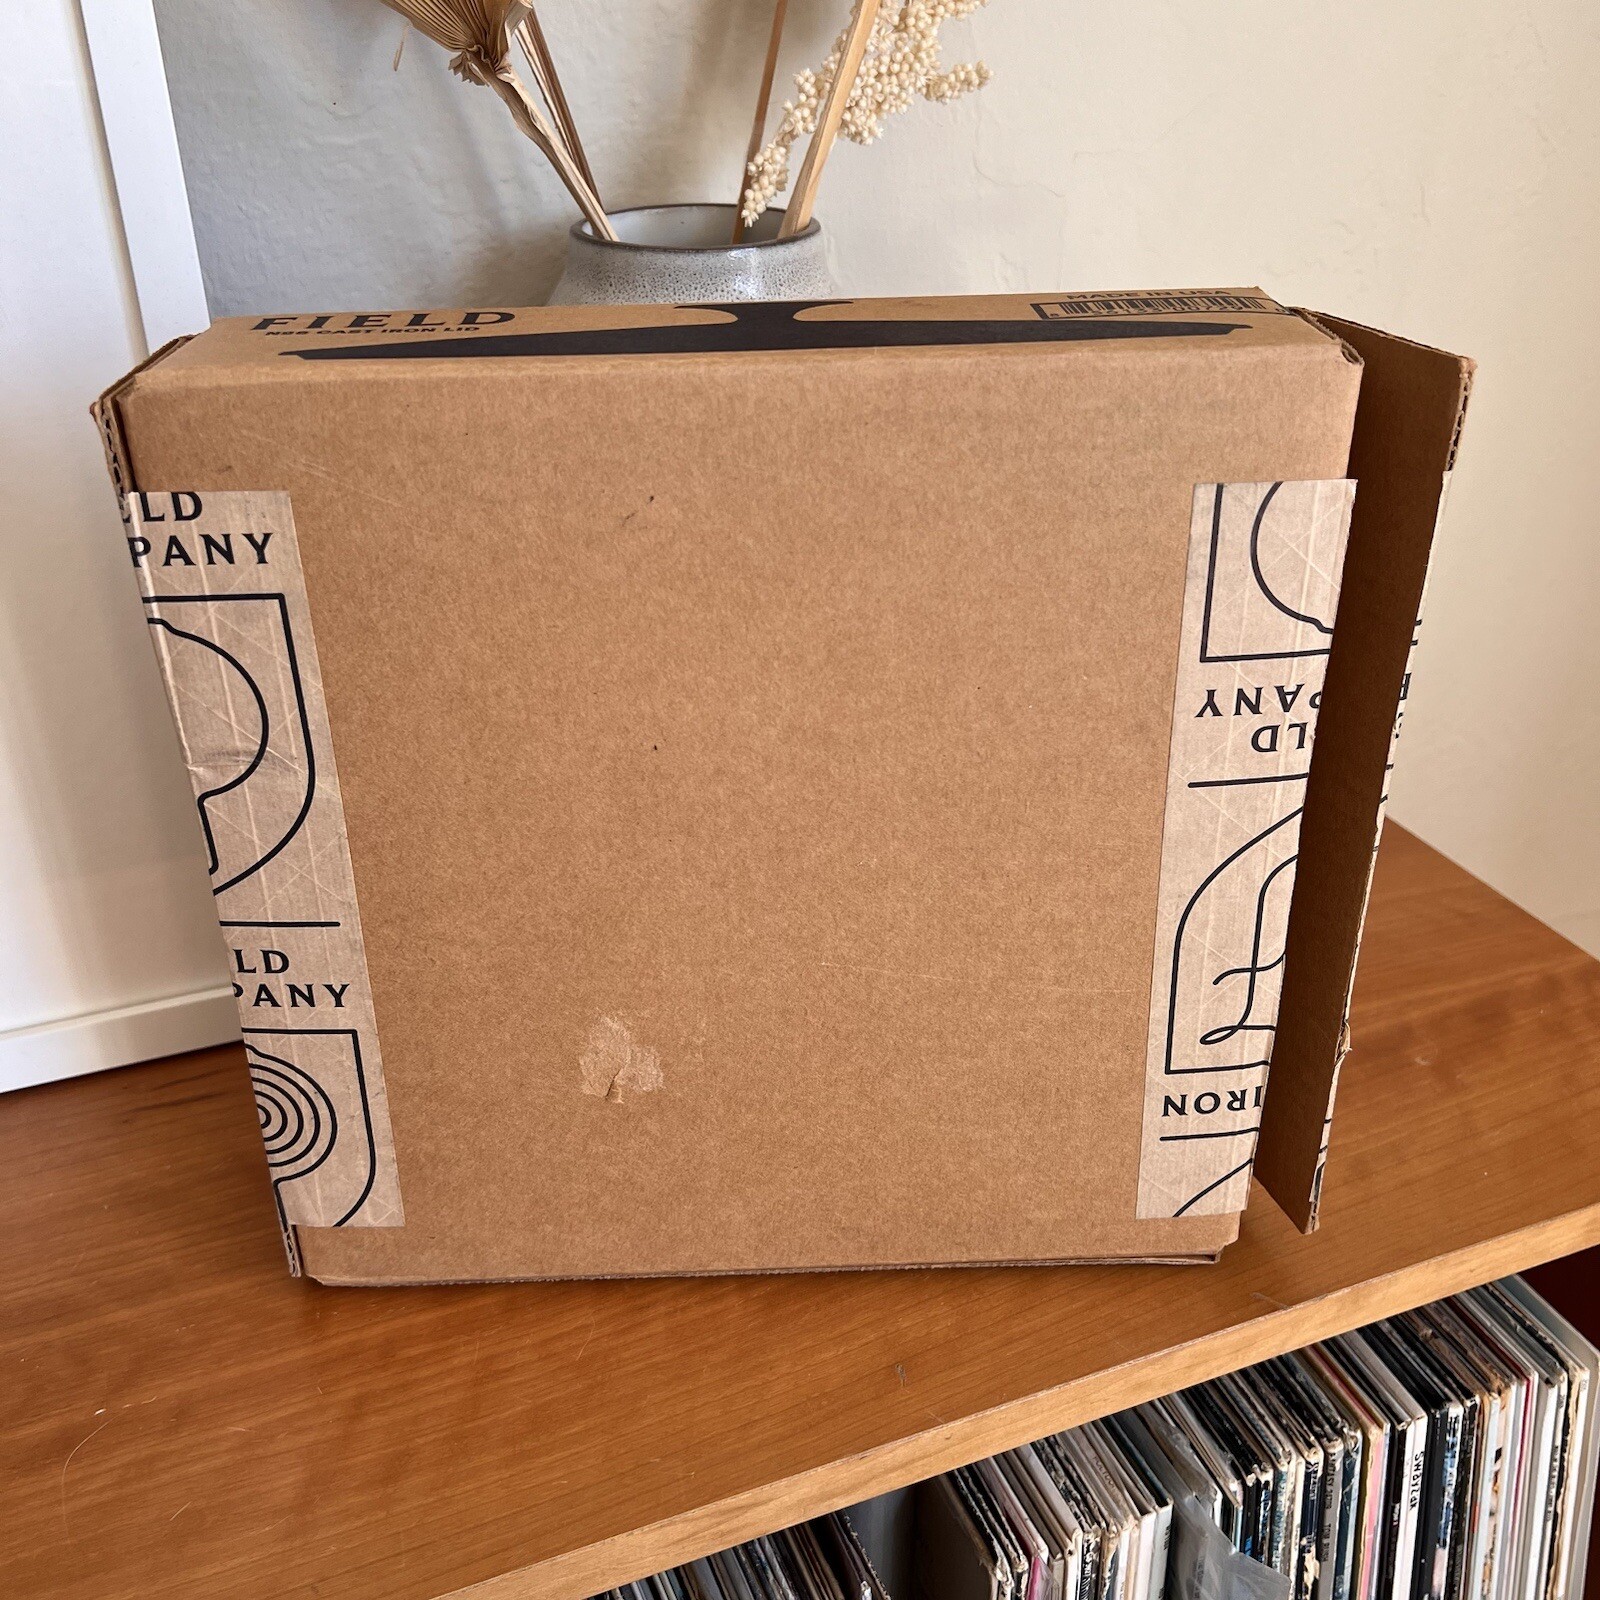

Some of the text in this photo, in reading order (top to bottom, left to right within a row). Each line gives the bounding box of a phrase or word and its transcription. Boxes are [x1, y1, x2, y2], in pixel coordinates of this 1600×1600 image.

[251, 311, 515, 331] FIELD
[123, 491, 203, 523] LD
[1161, 1084, 1265, 1118] IRON
